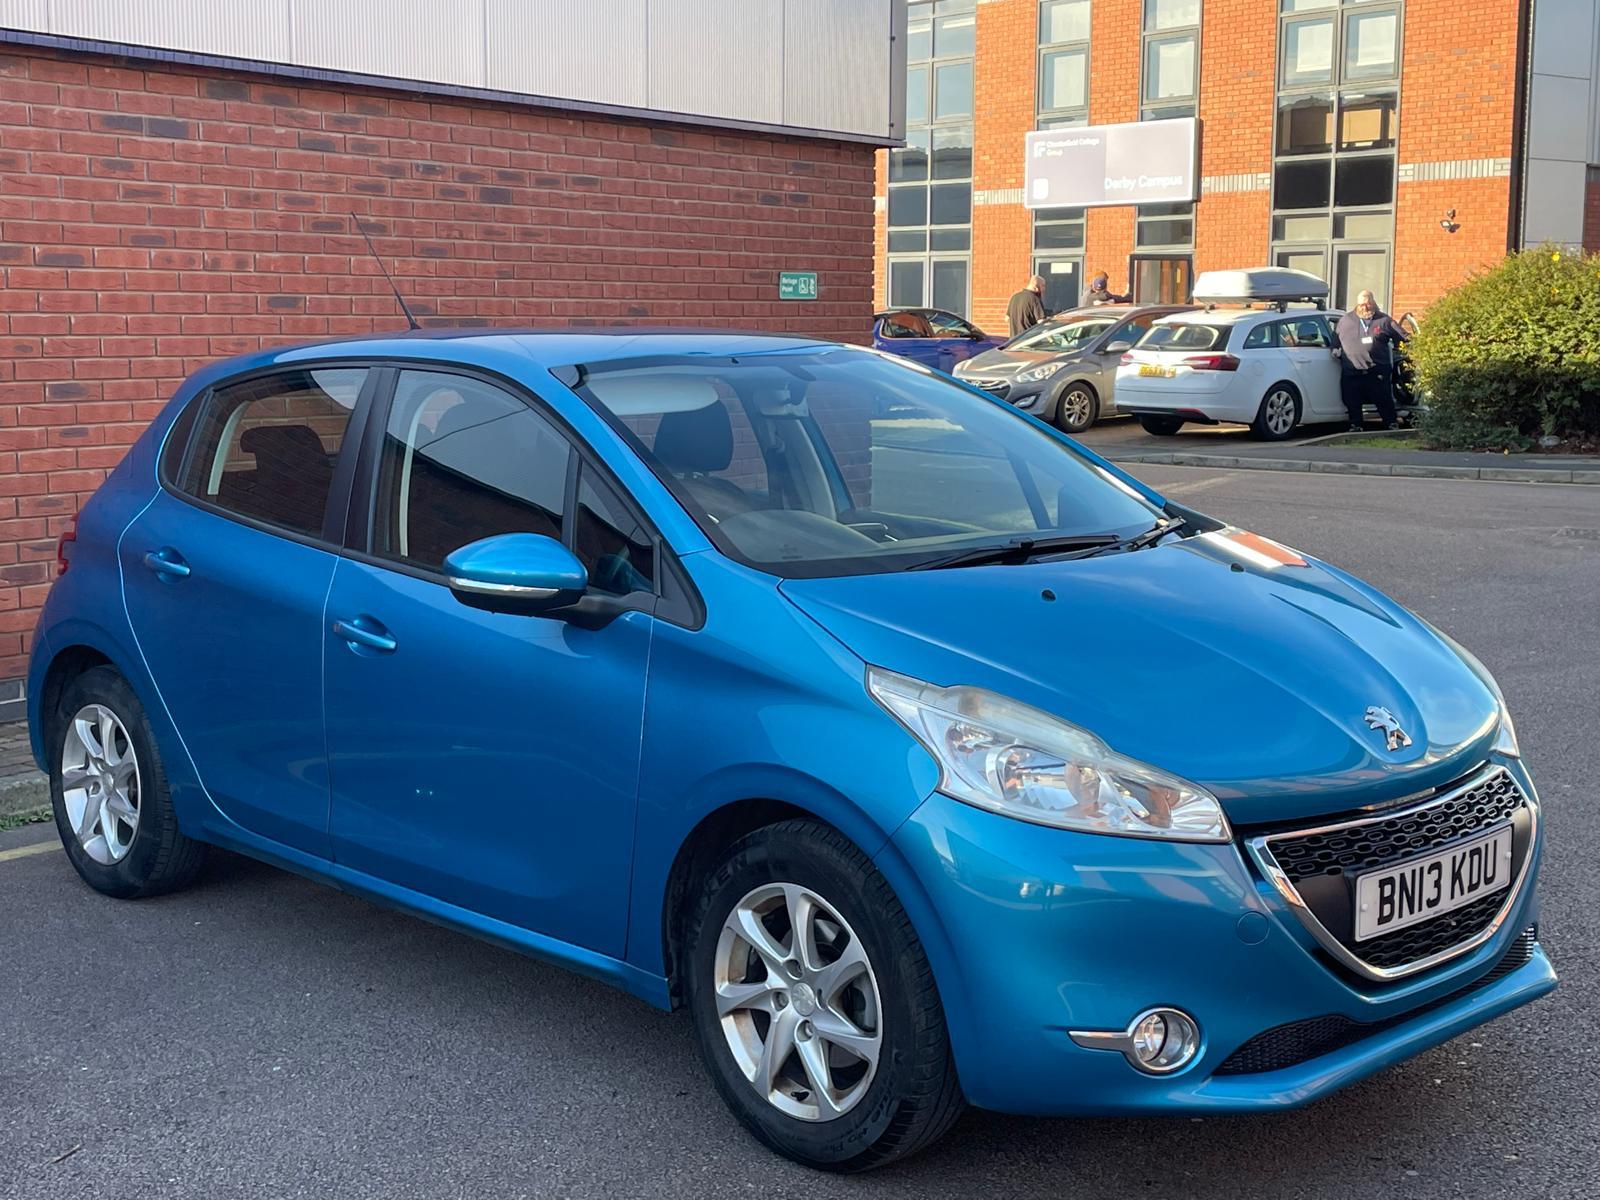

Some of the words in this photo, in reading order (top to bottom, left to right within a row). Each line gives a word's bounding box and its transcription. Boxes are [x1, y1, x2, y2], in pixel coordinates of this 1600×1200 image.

[1104, 178, 1136, 190] Derby
[1138, 175, 1184, 189] Campus
[1377, 861, 1443, 926] BN13
[1450, 840, 1498, 901] KDU
